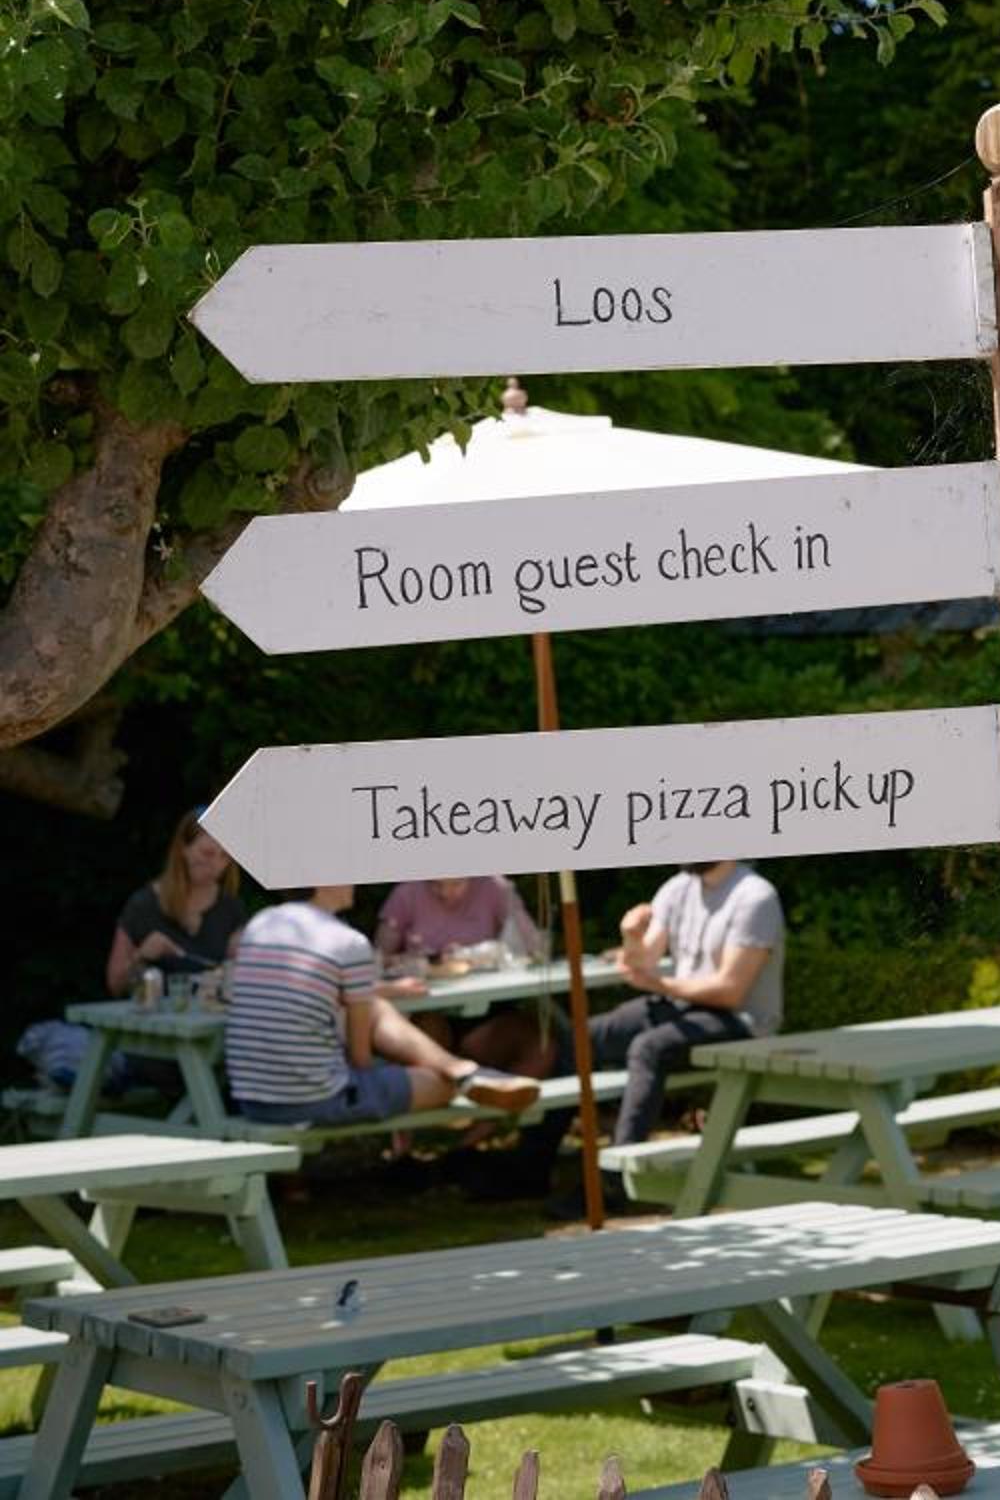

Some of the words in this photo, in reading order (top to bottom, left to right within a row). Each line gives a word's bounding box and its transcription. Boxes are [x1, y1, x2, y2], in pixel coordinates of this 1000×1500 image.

[552, 277, 673, 327] Loos
[353, 545, 493, 610] Room
[512, 541, 642, 615] guest
[656, 521, 778, 582] check
[793, 525, 832, 571] in
[350, 784, 604, 852] Takeaway
[625, 776, 752, 847] pizza
